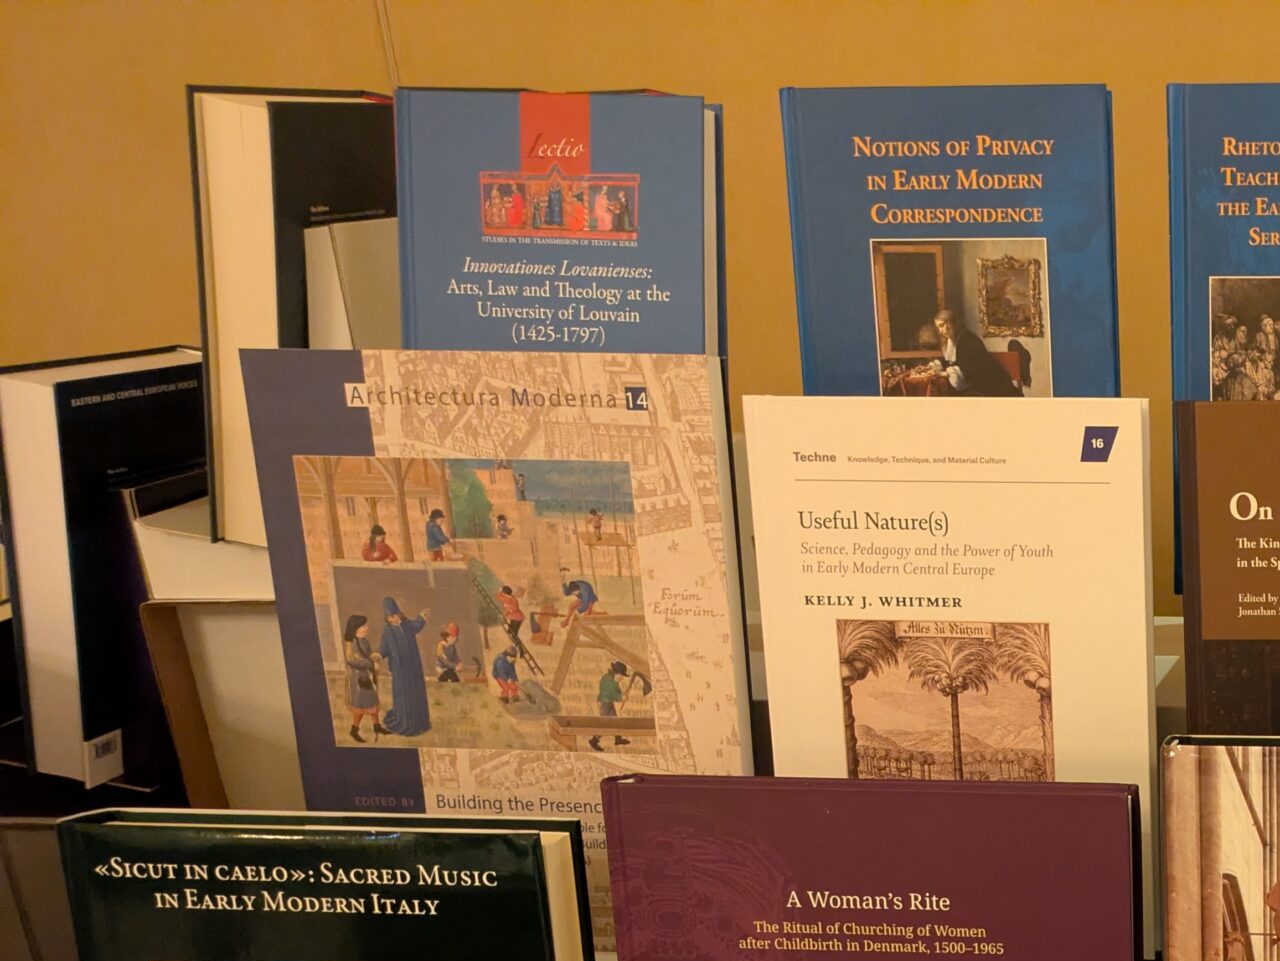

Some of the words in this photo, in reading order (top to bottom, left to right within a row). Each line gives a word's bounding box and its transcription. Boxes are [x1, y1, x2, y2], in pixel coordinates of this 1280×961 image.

[464, 257, 556, 275] Innovationes
[559, 260, 653, 278] Lovanienses:
[447, 279, 483, 296] Arts,
[488, 280, 518, 296] Law
[523, 280, 550, 297] and
[554, 282, 623, 305] Theology
[627, 289, 641, 300] at
[646, 284, 670, 302] the
[477, 301, 554, 320] University
[558, 303, 576, 320] of
[580, 304, 640, 322] Louvain
[512, 323, 605, 346] (1425-1797)
[350, 386, 500, 406] Architectura
[511, 387, 617, 408] Moderna
[626, 391, 649, 410] 14
[1091, 438, 1104, 448] 16
[792, 451, 836, 462] Techne
[1230, 492, 1274, 520] On
[798, 510, 858, 530] Useful
[864, 511, 948, 537] Nature(s)
[804, 595, 854, 606] KELLY
[860, 596, 872, 610] J.
[878, 596, 962, 608] WHITMER
[436, 794, 503, 814] Building
[507, 796, 534, 812] the
[539, 797, 602, 814] Presenc
[739, 936, 771, 950] after
[774, 937, 843, 951] Childbirth
[846, 939, 860, 952] in
[864, 940, 930, 954] Denmark,
